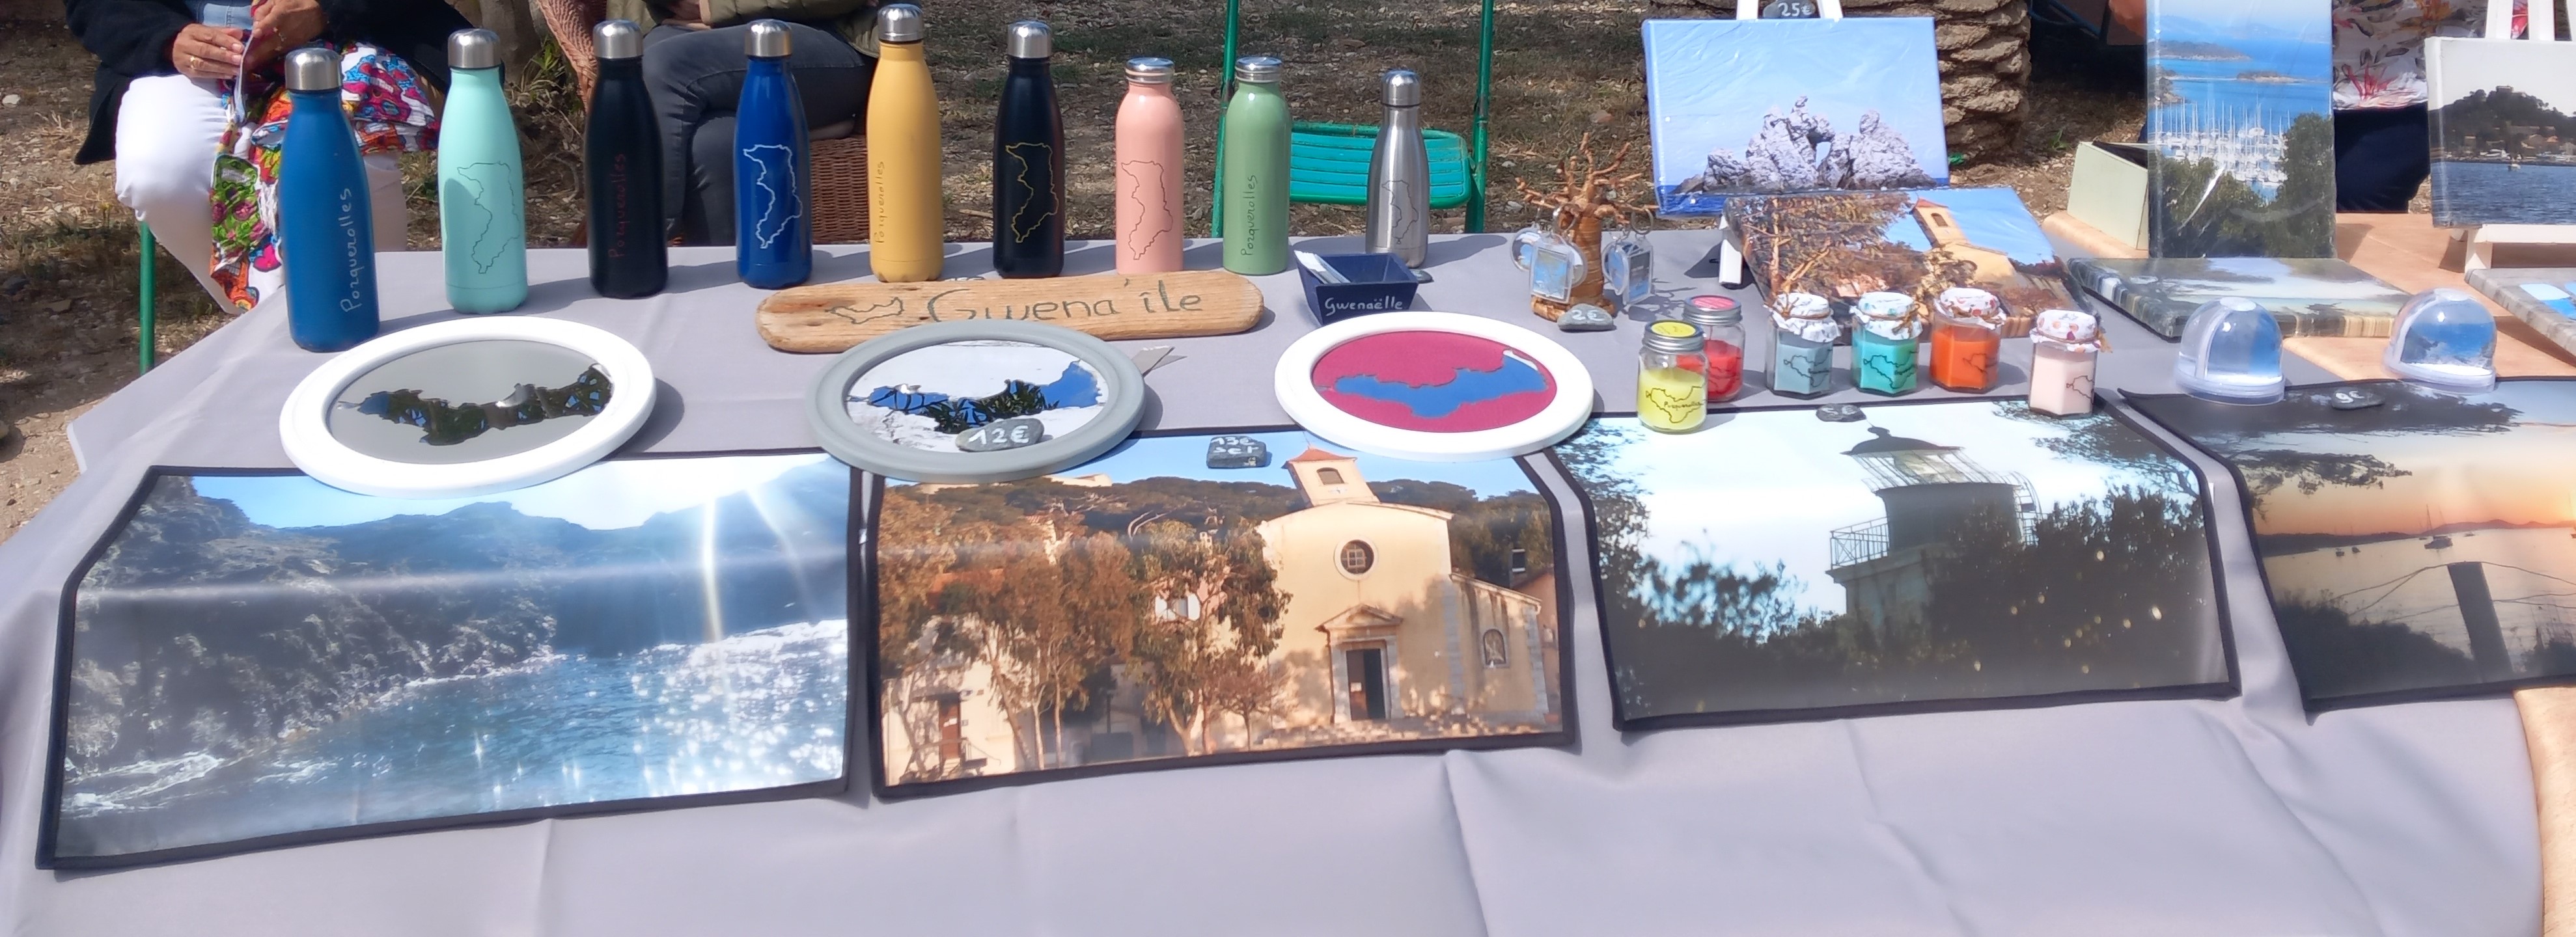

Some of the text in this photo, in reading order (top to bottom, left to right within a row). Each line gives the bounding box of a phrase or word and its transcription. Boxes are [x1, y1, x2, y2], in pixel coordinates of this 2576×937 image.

[1778, 2, 1812, 17] 25€
[1240, 174, 1260, 256] Porquerolles
[338, 187, 365, 312] Porquerolles
[1325, 295, 1403, 317] Gwenaëlle
[1571, 309, 1605, 321] 2€
[967, 424, 1030, 445] 12€
